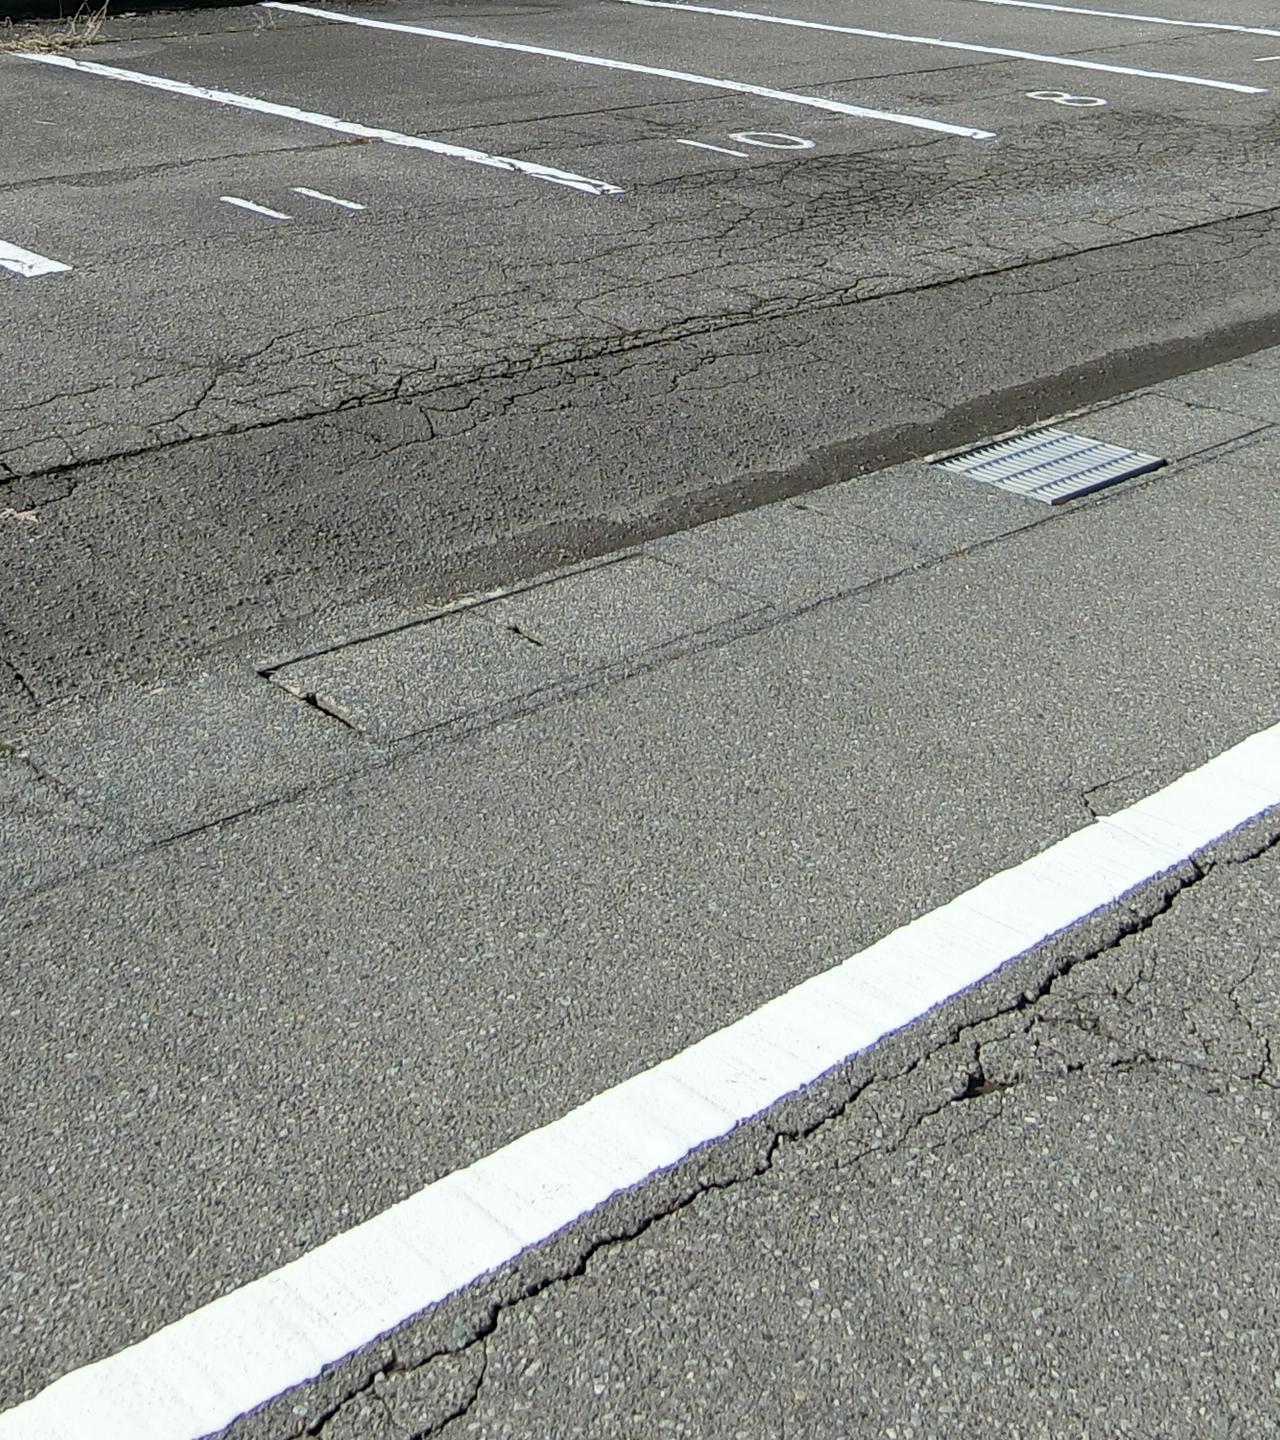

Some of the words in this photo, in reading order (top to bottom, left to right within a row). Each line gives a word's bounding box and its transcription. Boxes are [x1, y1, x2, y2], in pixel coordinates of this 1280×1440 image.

[1025, 91, 1108, 107] 8
[676, 132, 815, 158] 10
[221, 187, 365, 220] 11
